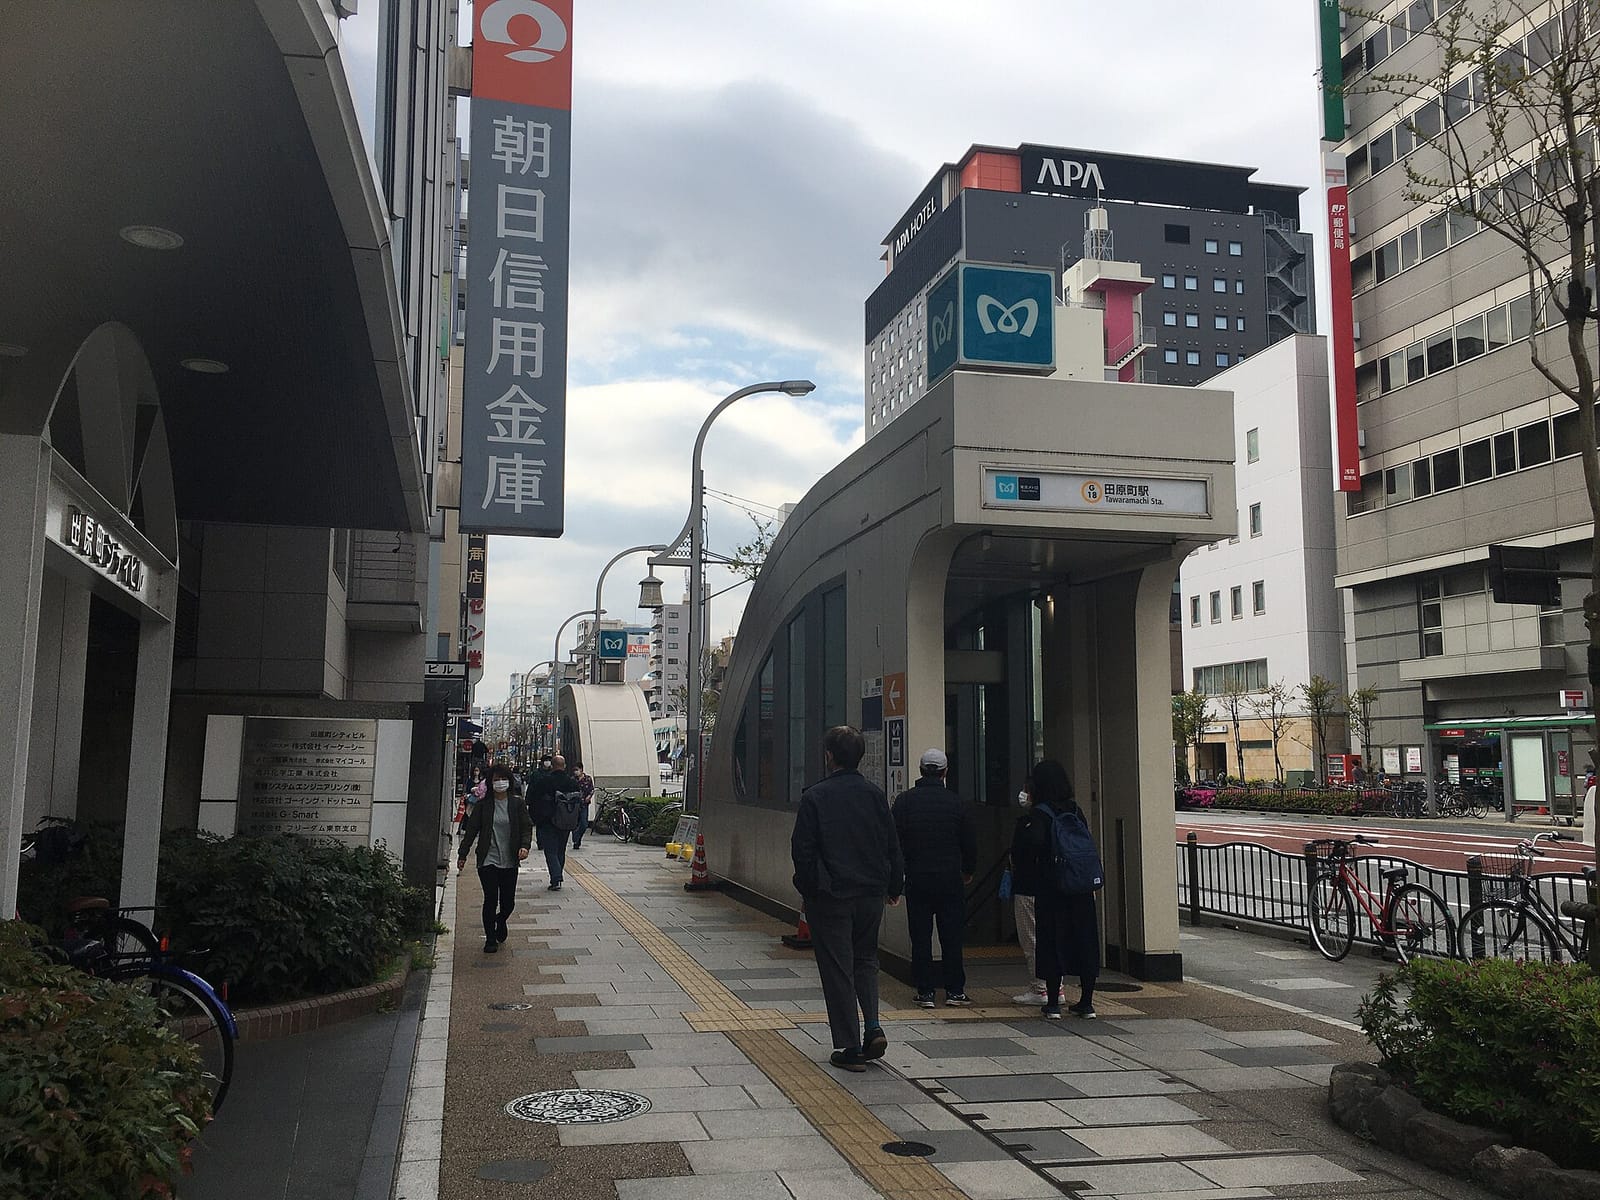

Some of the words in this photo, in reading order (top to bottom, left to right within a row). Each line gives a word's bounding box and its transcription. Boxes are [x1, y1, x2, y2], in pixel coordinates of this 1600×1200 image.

[1037, 158, 1105, 190] APA
[895, 228, 910, 257] APA
[910, 196, 937, 240] HOTEL
[1333, 217, 1344, 250] 郵便局
[481, 114, 552, 514] 朝日信用金庫
[1087, 491, 1098, 499] 18
[1104, 483, 1149, 497] 田原町駅
[1104, 496, 1150, 505] Tawaramachi
